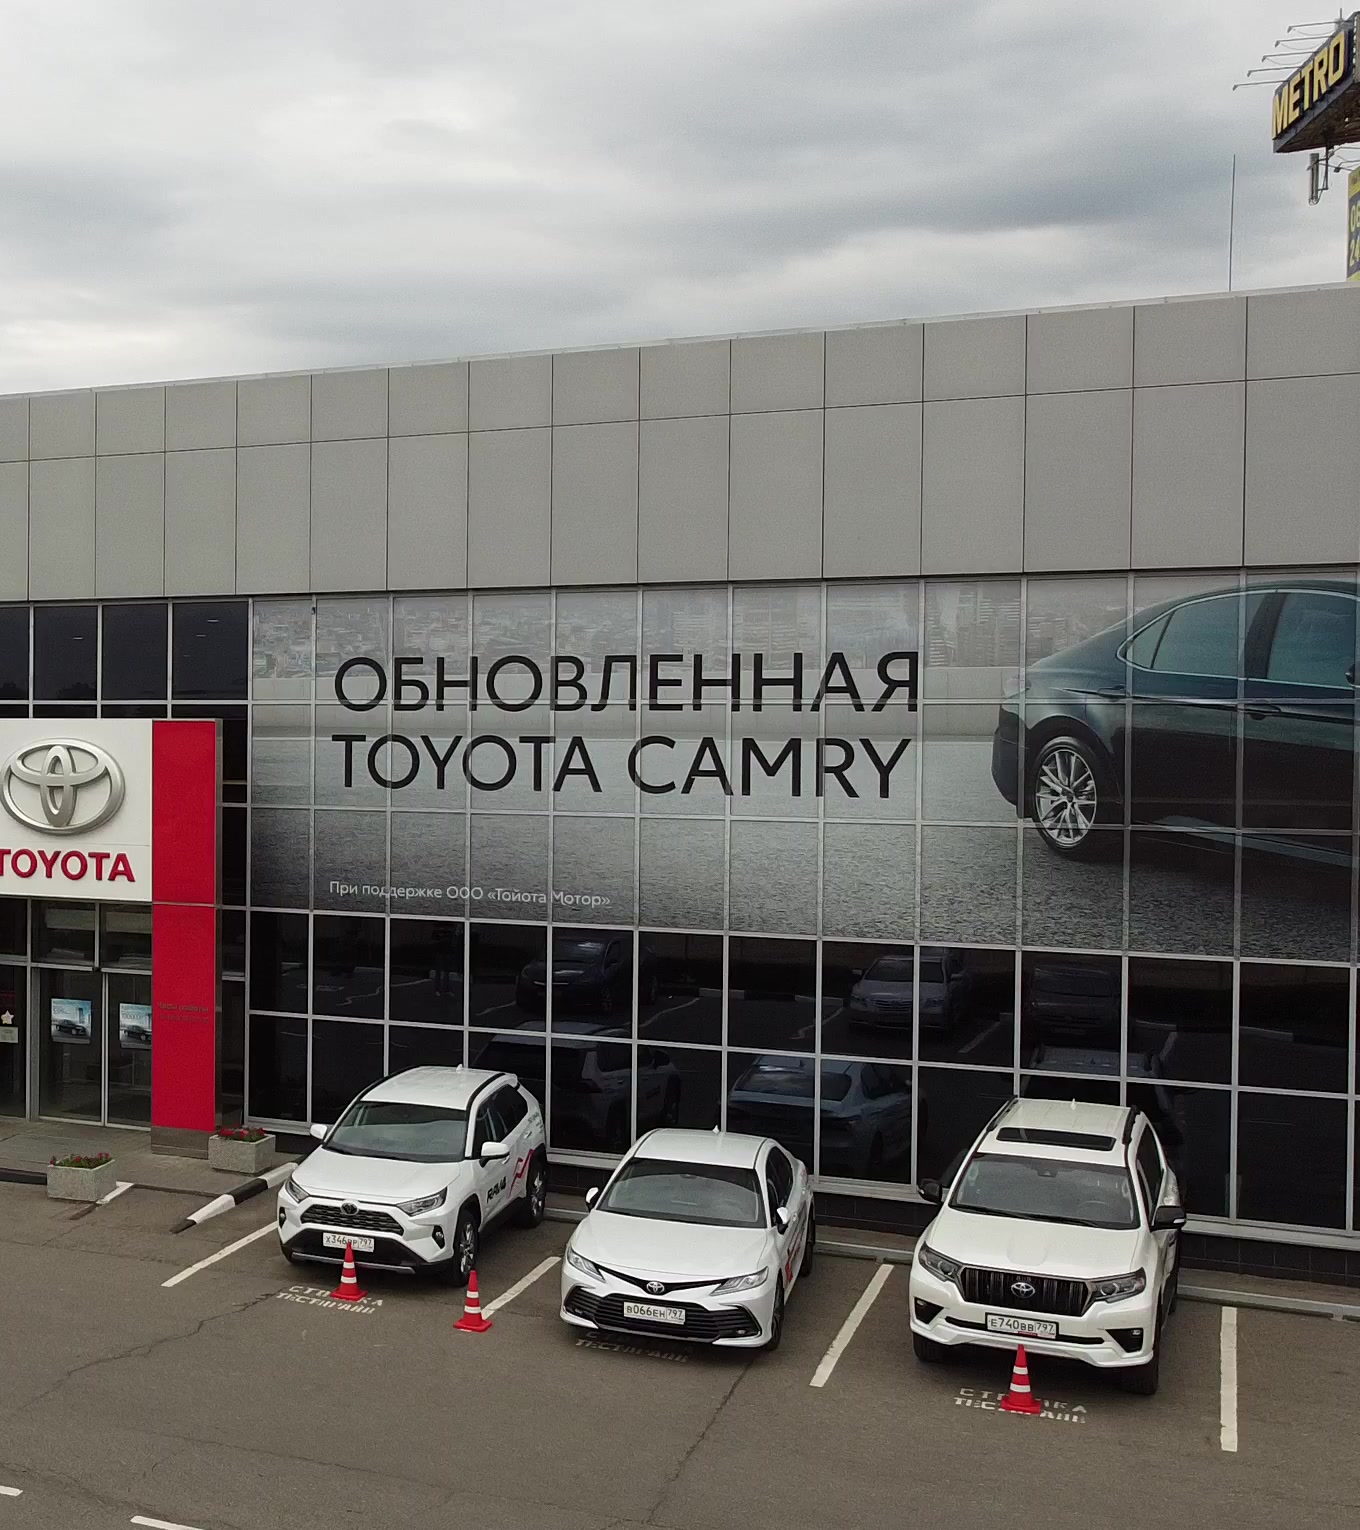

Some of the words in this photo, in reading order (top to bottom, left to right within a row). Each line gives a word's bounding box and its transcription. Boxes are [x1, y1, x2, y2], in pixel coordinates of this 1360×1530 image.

[1272, 31, 1345, 140] METRO
[334, 651, 919, 715] ОБНОВЛЕННАЯ
[332, 734, 602, 793] TOYOTA
[628, 735, 912, 799] CAMRY
[329, 880, 358, 898] При
[362, 884, 442, 899] поддержке
[446, 886, 483, 900] ООО
[488, 886, 546, 902] «Тойота
[551, 889, 610, 908] Мотор»
[626, 1304, 666, 1318] В066ЕН
[668, 1308, 682, 1318] 797
[990, 1317, 1034, 1332] Е740ВВ
[1036, 1322, 1054, 1333] 797
